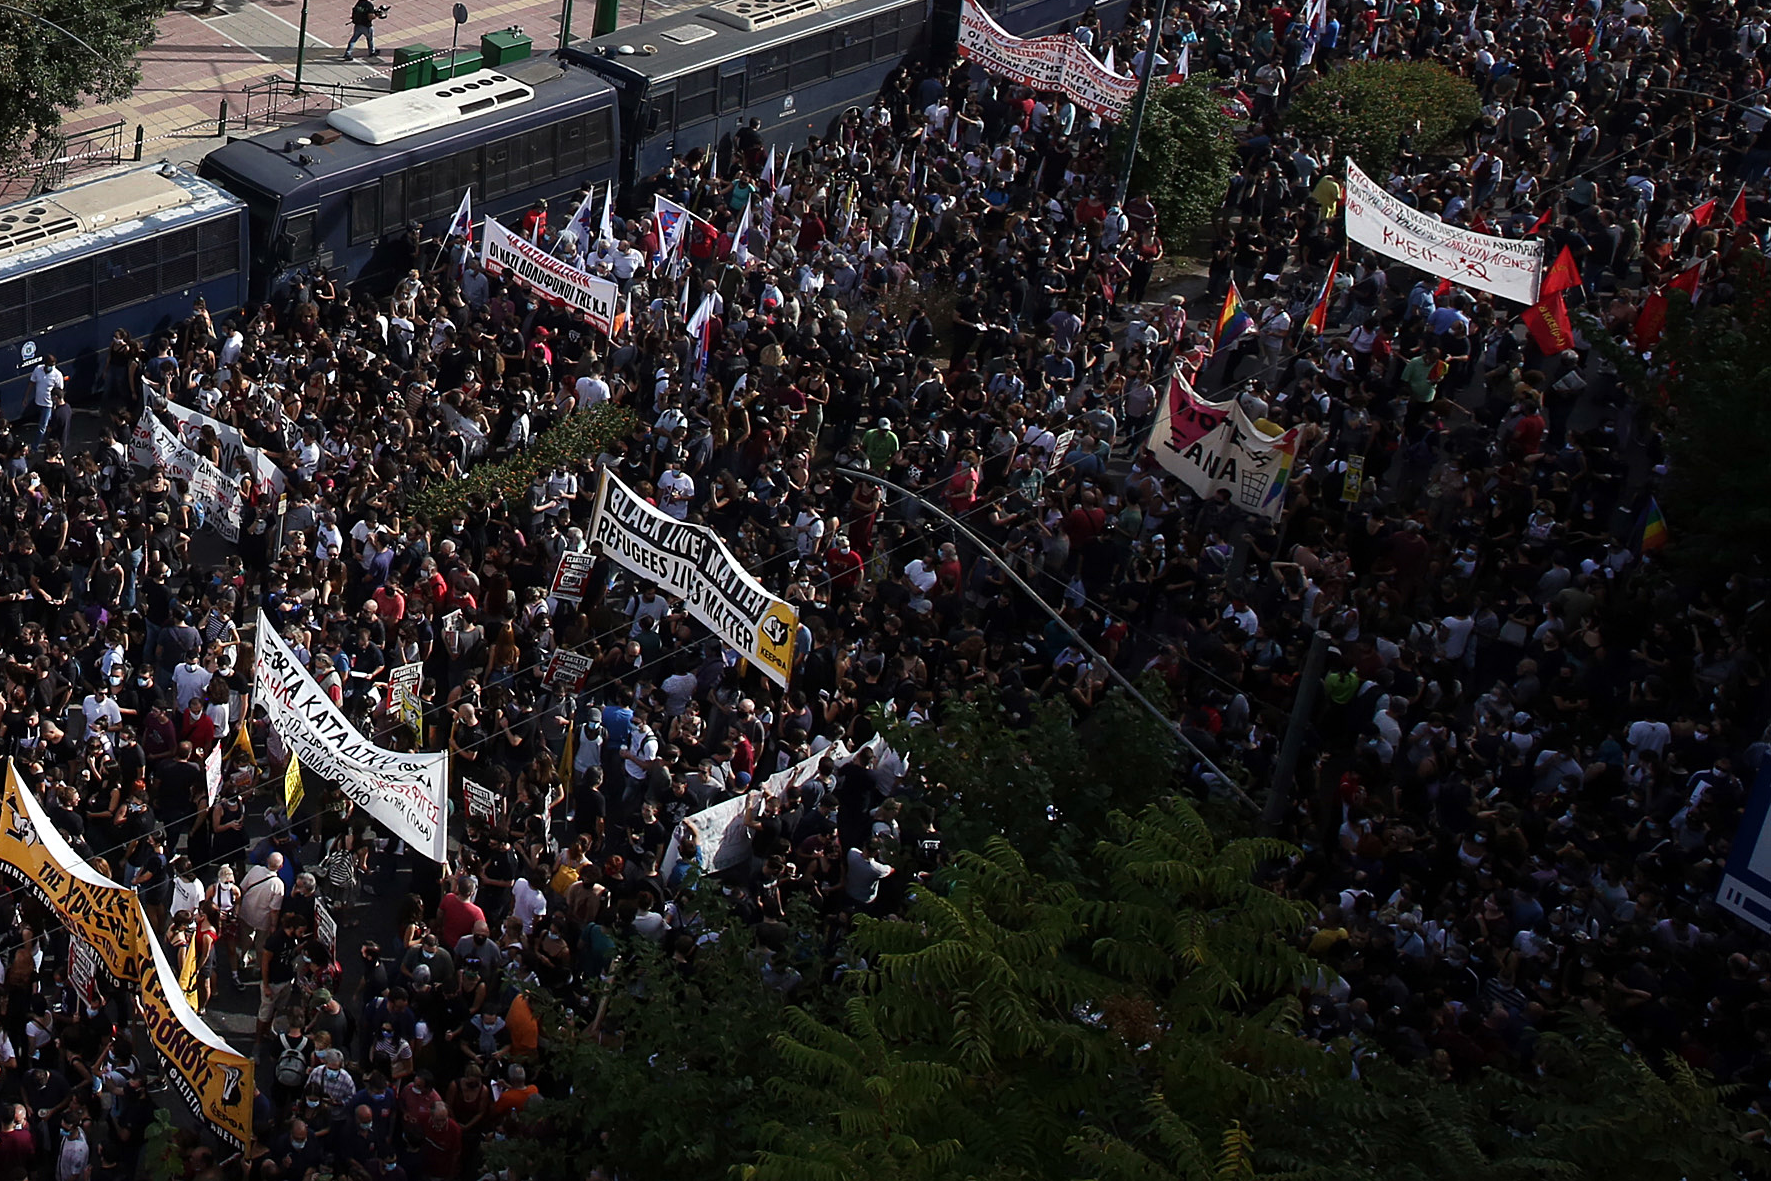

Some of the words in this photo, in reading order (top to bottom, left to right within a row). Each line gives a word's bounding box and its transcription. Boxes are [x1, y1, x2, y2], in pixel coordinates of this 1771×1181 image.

[968, 51, 1026, 83] ΣΥΝΔΙΚΑΤΟ
[970, 41, 1021, 69] ΚΑΤΑΔΙΚΗ
[518, 259, 575, 301] ΔΟΛΟΦΟΝΟΙ
[576, 289, 592, 309] ΤΗΣ
[1164, 426, 1237, 483] ΞΑΝΑ
[610, 488, 664, 541] BLACK
[662, 524, 708, 564] LIVES
[705, 552, 766, 615] MATTER
[597, 516, 668, 579] REFUGEES
[704, 589, 754, 653] MATTER
[299, 694, 396, 769] ΚΑΤΑΔΙΚΗ
[299, 746, 372, 808] ΠΑΙΔΑΓΩΓΙΚΟ
[37, 860, 64, 892] ΤΗΣ
